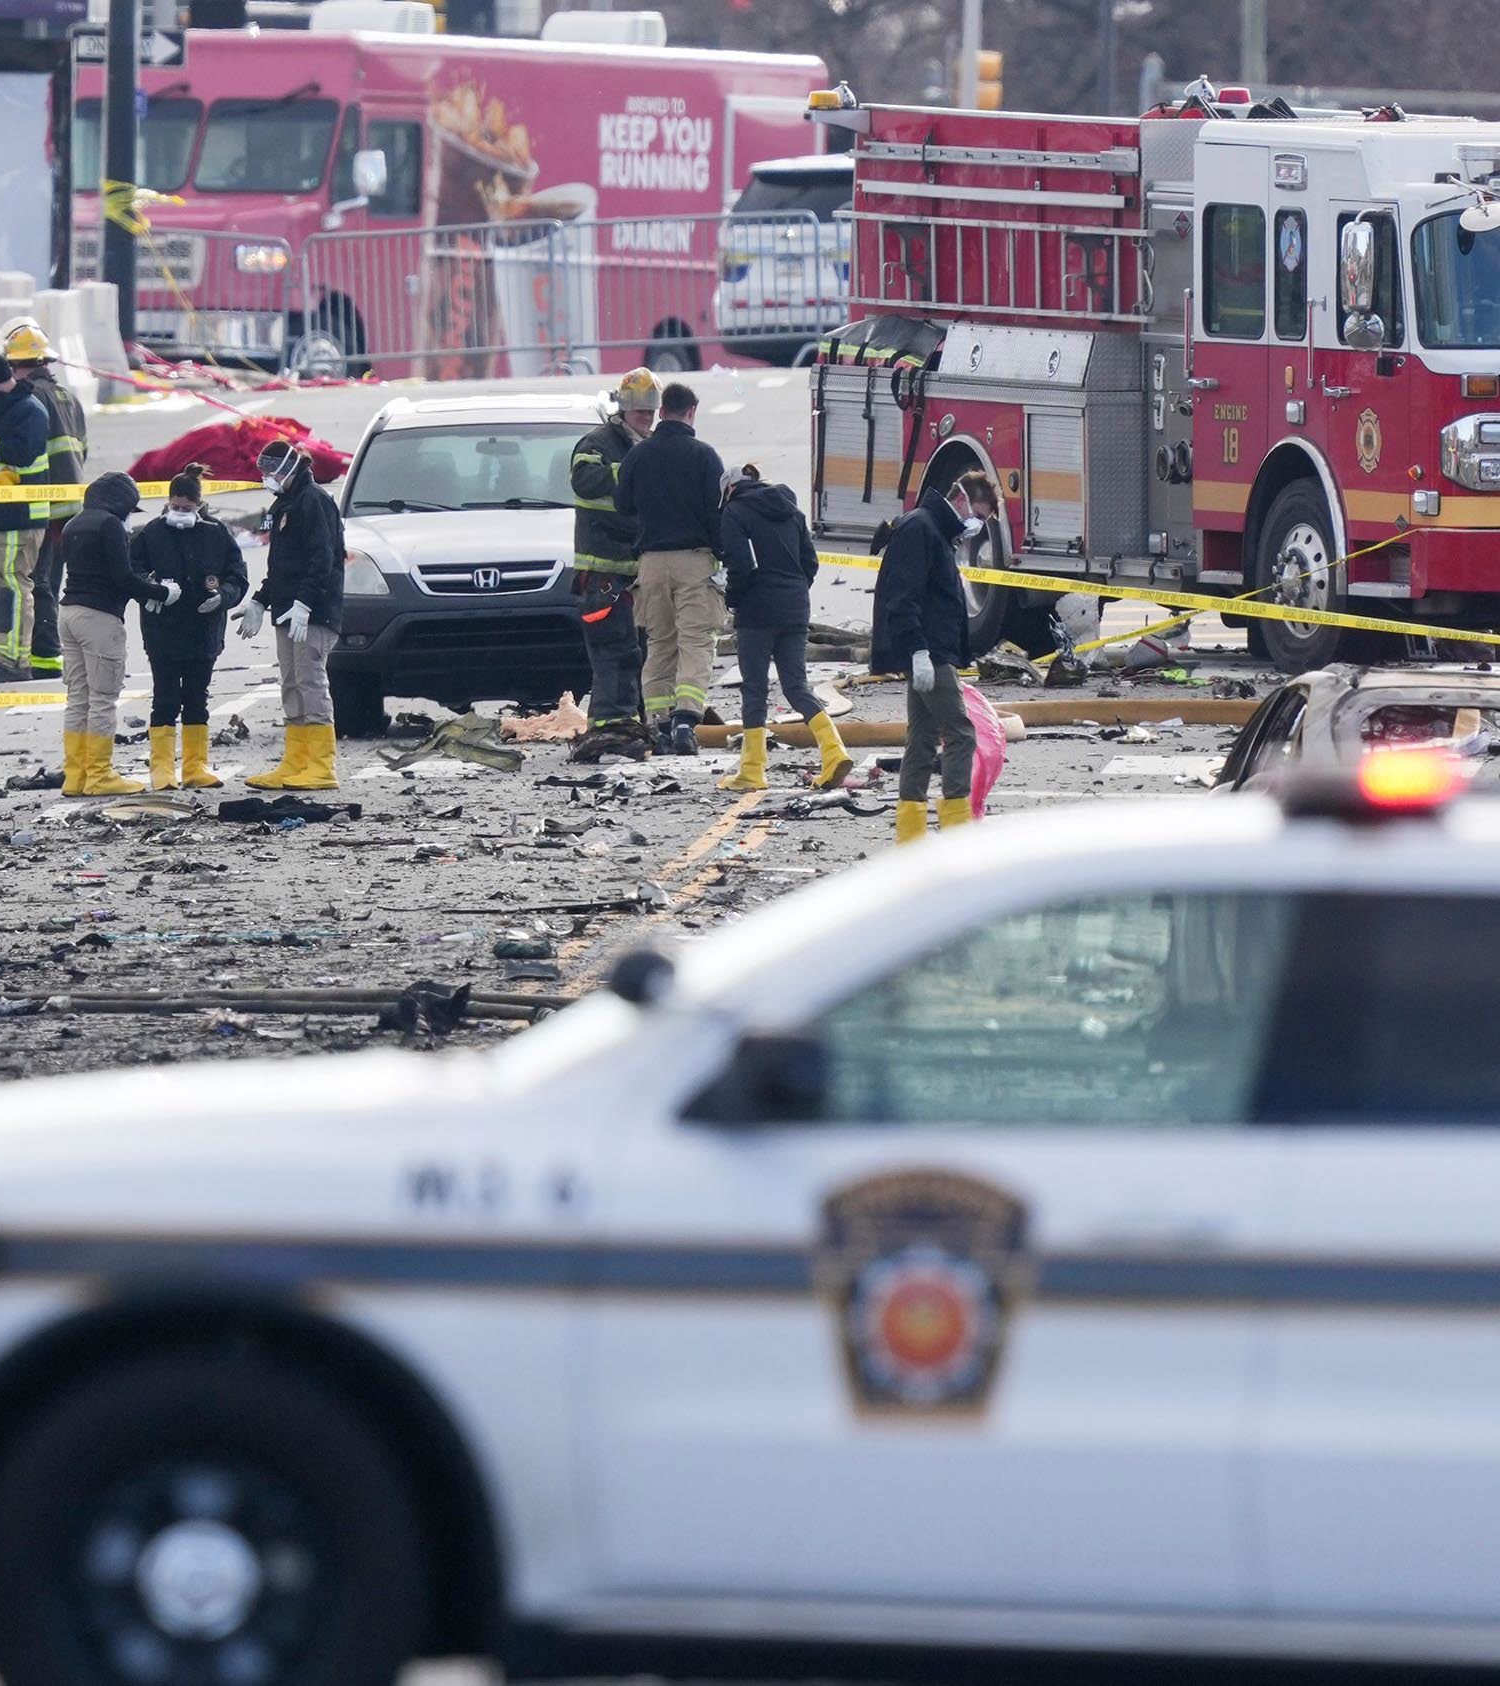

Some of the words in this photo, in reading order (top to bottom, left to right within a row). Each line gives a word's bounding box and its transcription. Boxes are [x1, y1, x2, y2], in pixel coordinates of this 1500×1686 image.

[600, 115, 657, 149] KEEP
[661, 116, 712, 153] YOU
[602, 152, 709, 191] RUNNING
[1214, 404, 1248, 421] ENGINE
[1222, 427, 1239, 464] 18
[1034, 505, 1040, 526] 2
